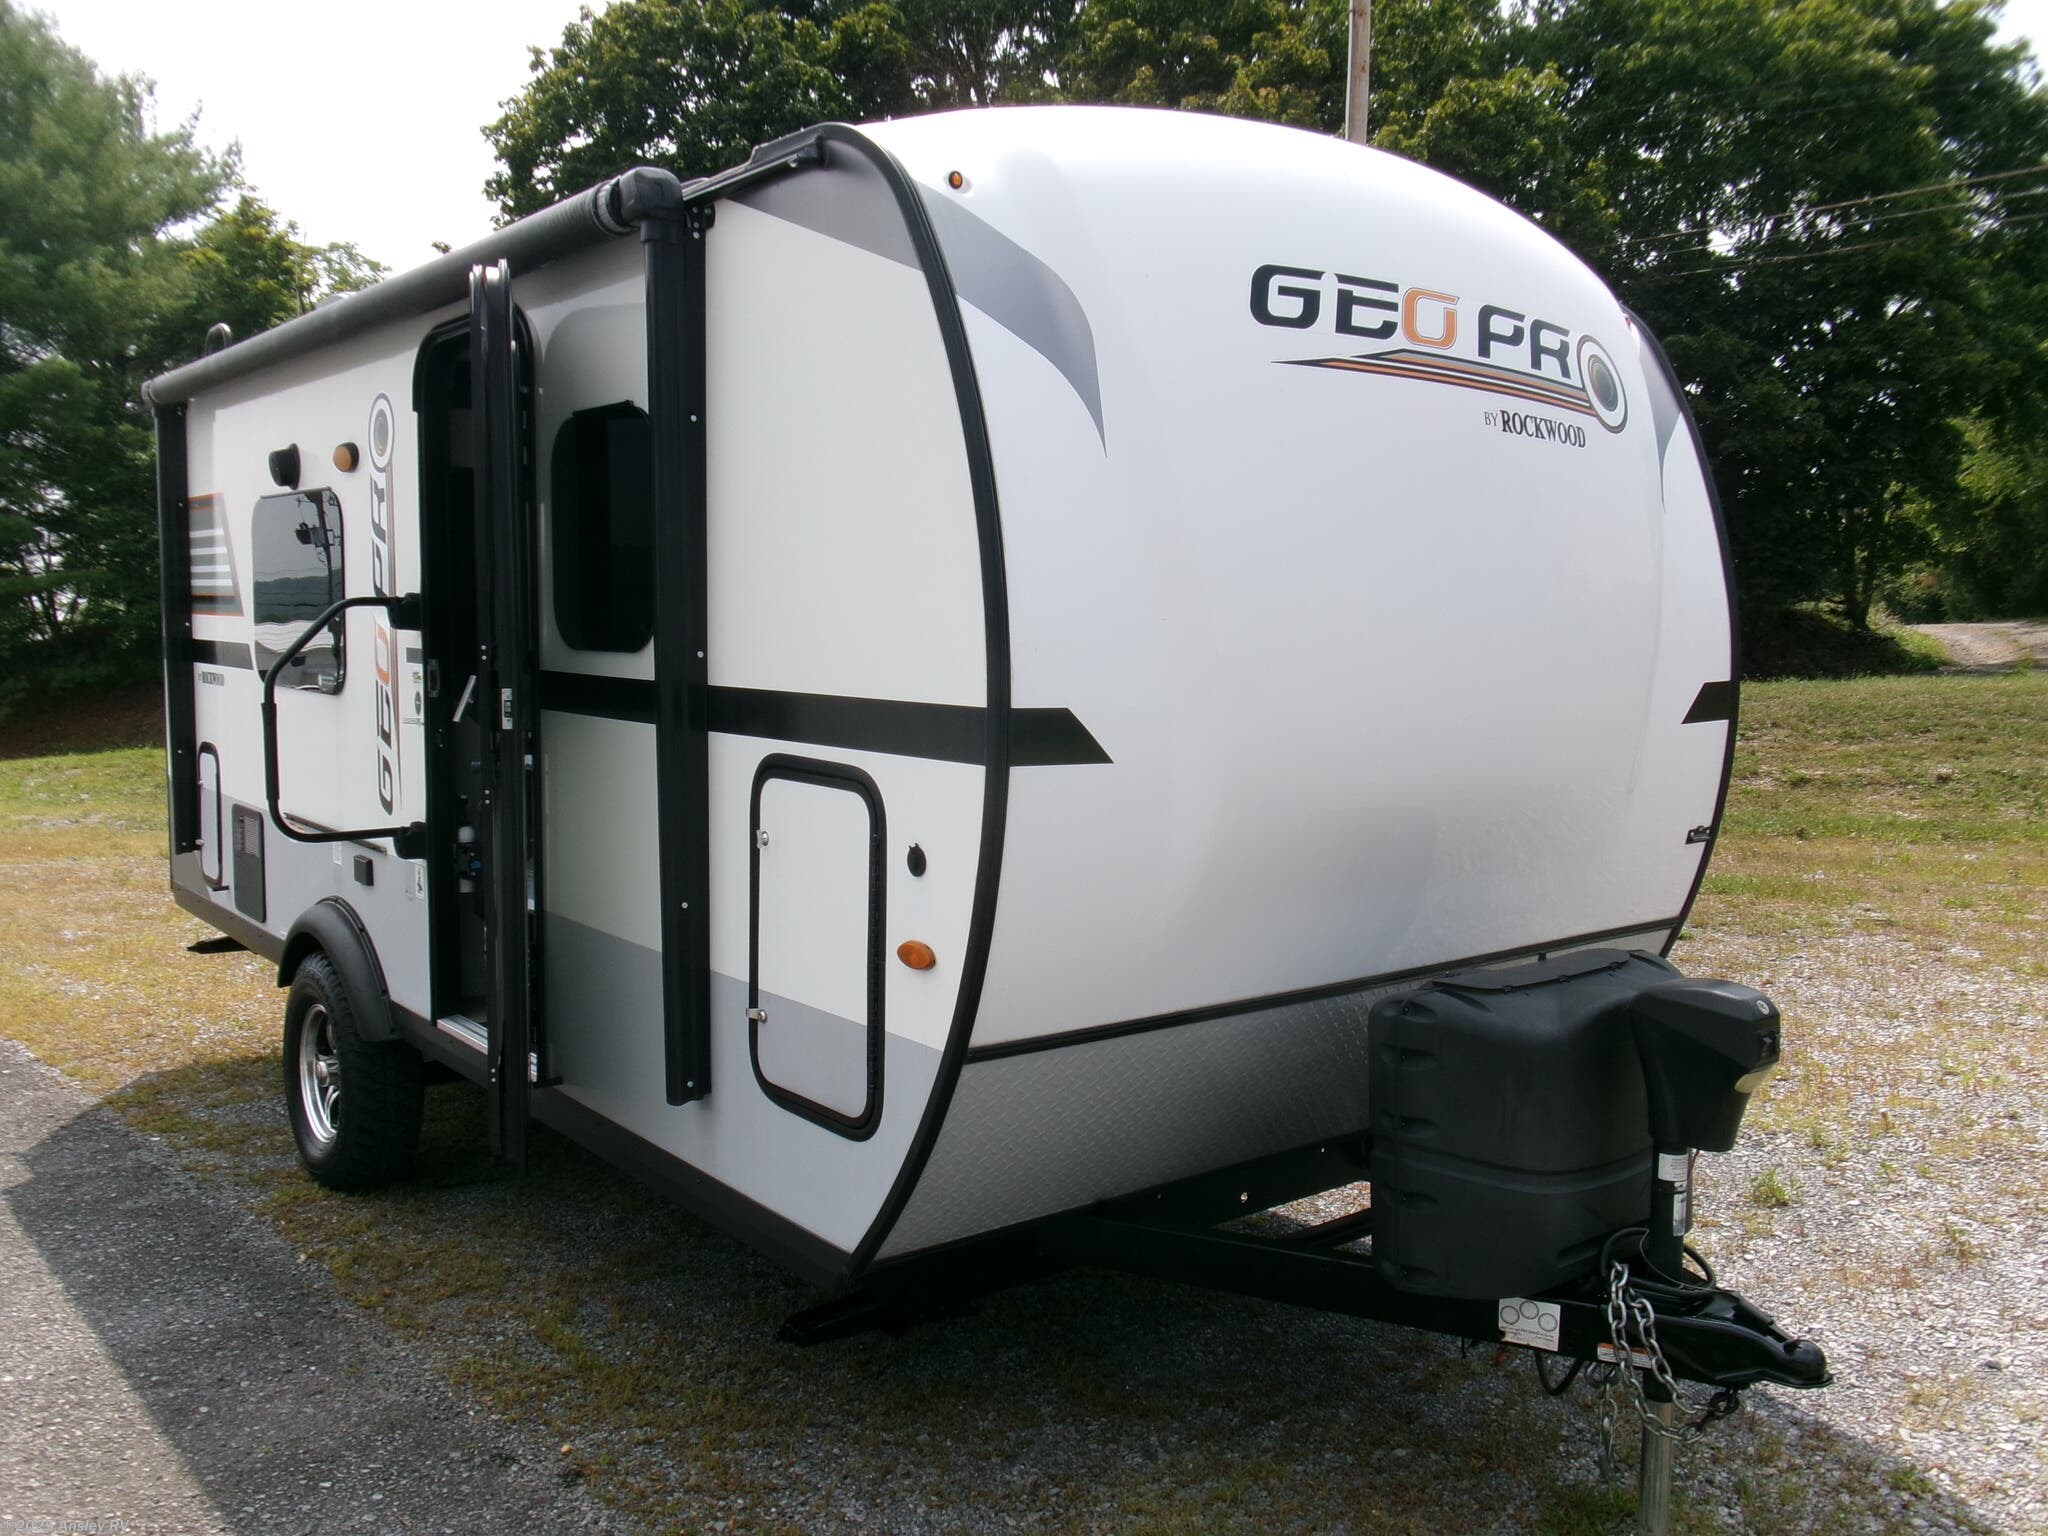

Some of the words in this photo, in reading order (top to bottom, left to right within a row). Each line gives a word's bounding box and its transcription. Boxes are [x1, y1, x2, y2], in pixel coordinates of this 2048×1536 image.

[1249, 263, 1460, 350] GEO
[1477, 303, 1628, 434] PRO
[1484, 411, 1498, 427] BY
[1500, 409, 1586, 448] ROCKWOOD
[368, 392, 395, 598] PRO
[374, 620, 394, 816] GEO
